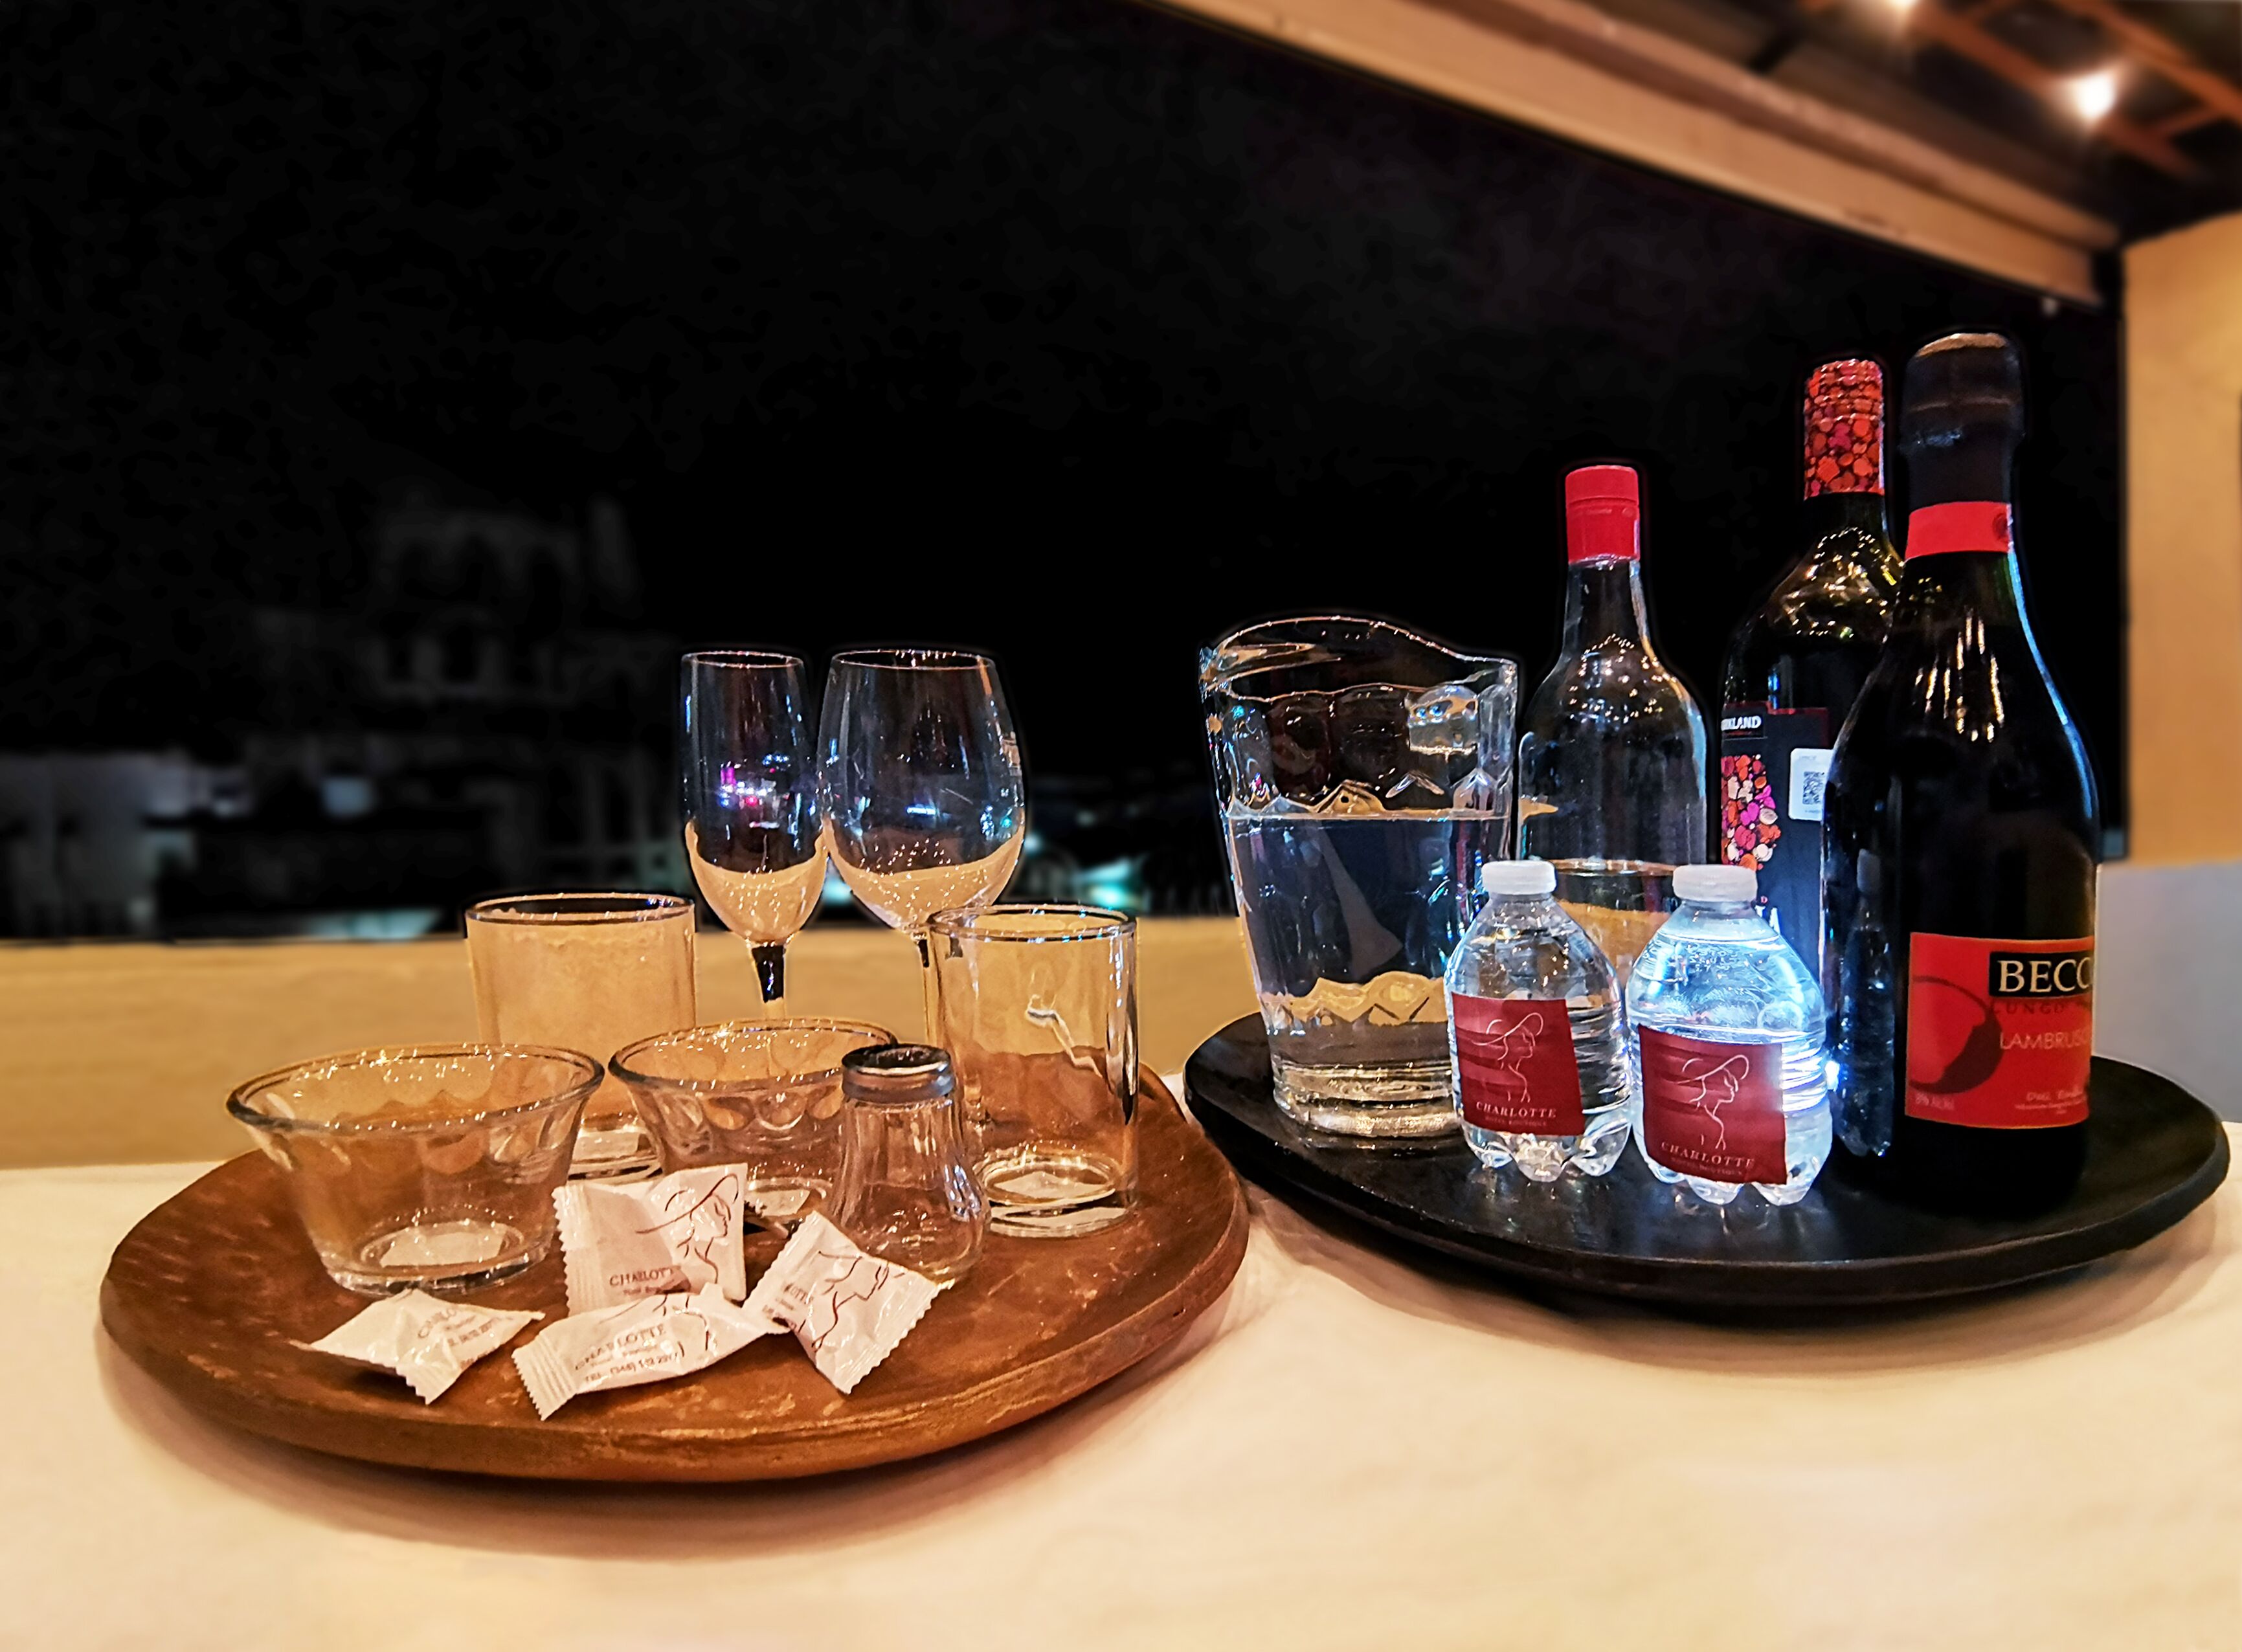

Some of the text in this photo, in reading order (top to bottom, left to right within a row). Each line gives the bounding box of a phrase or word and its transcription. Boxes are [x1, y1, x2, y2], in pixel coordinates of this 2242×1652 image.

[1997, 957, 2093, 992] BECC
[1476, 1101, 1556, 1118] CHARLOTTE
[1661, 1141, 1755, 1168] CHARLOTTE
